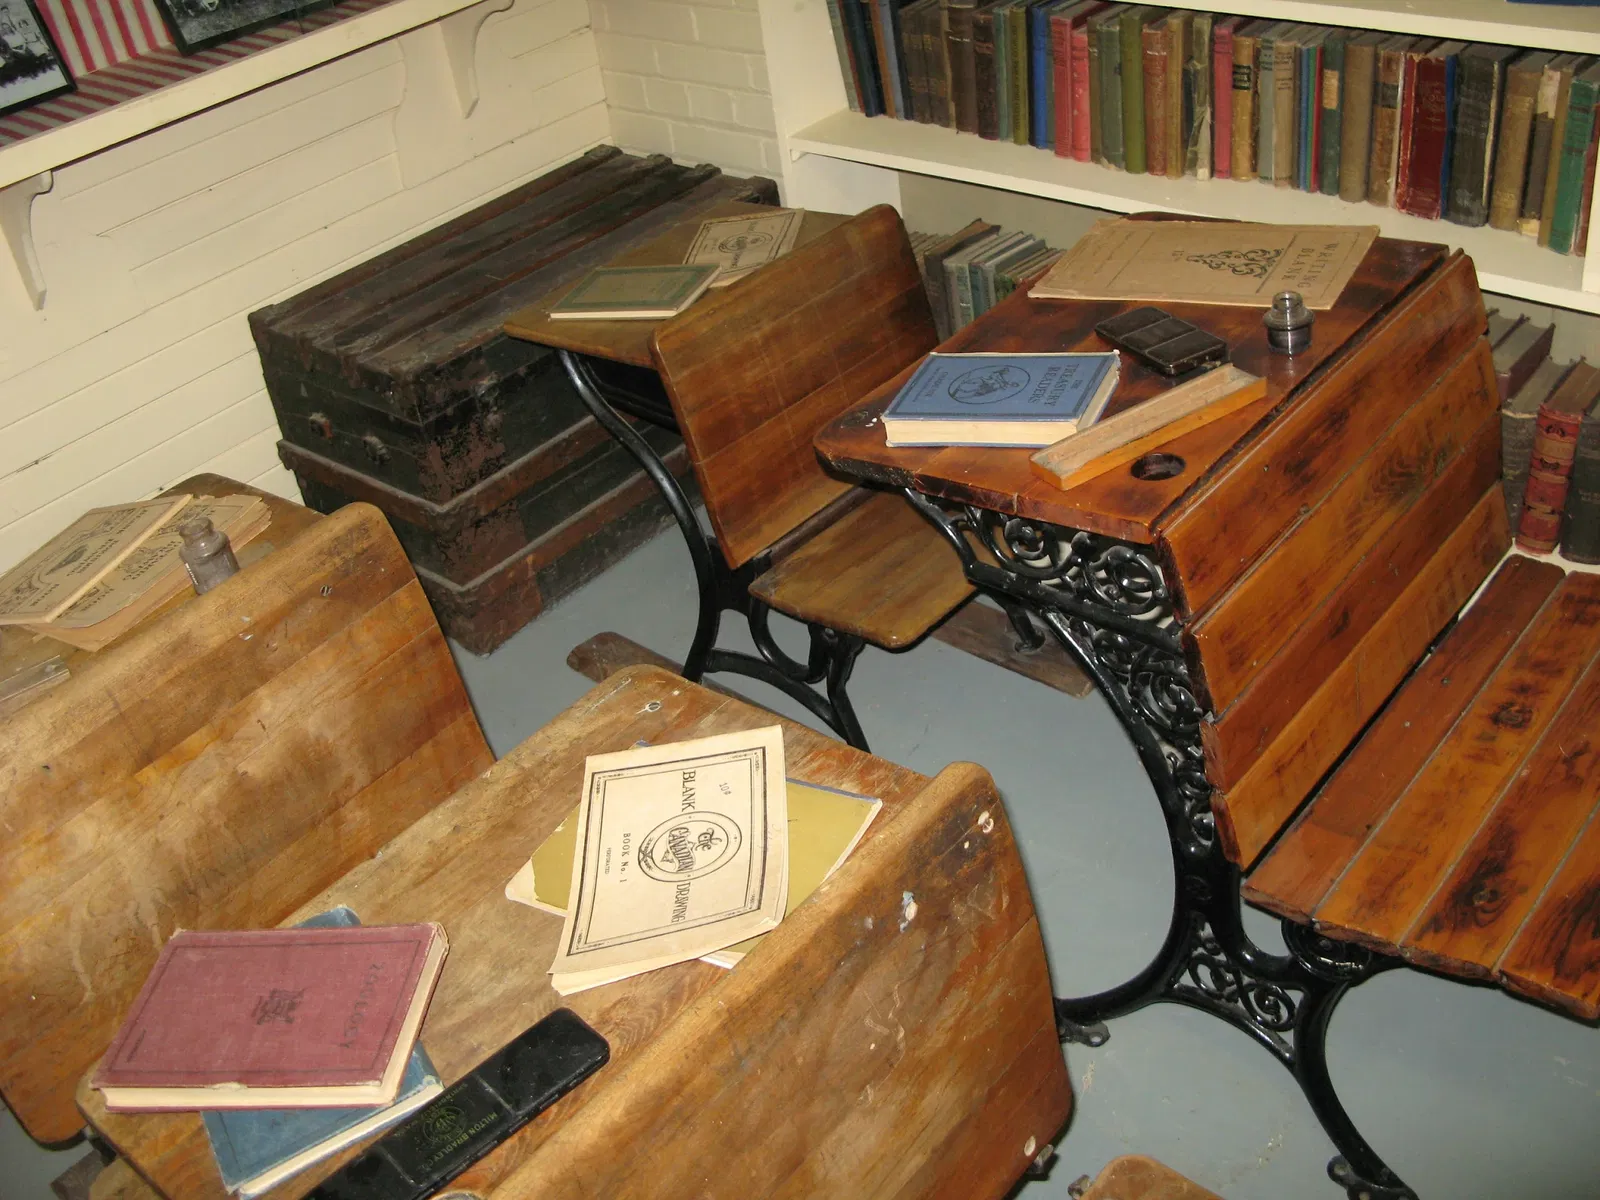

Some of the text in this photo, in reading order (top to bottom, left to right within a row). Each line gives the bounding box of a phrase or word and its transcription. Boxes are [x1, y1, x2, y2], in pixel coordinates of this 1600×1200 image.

[1280, 247, 1316, 281] BLANK
[1297, 242, 1341, 289] WRITING
[1027, 366, 1061, 404] READERS
[1043, 363, 1080, 407] TREASURY
[621, 832, 632, 857] BOOK
[667, 826, 694, 872] CANADIAN
[670, 769, 697, 923] BLANK DRAWING
[619, 859, 630, 875] No.
[336, 962, 384, 1049] ZOOLOGY
[470, 1111, 499, 1135] MILTON
[434, 1132, 470, 1162] BRADLEY
